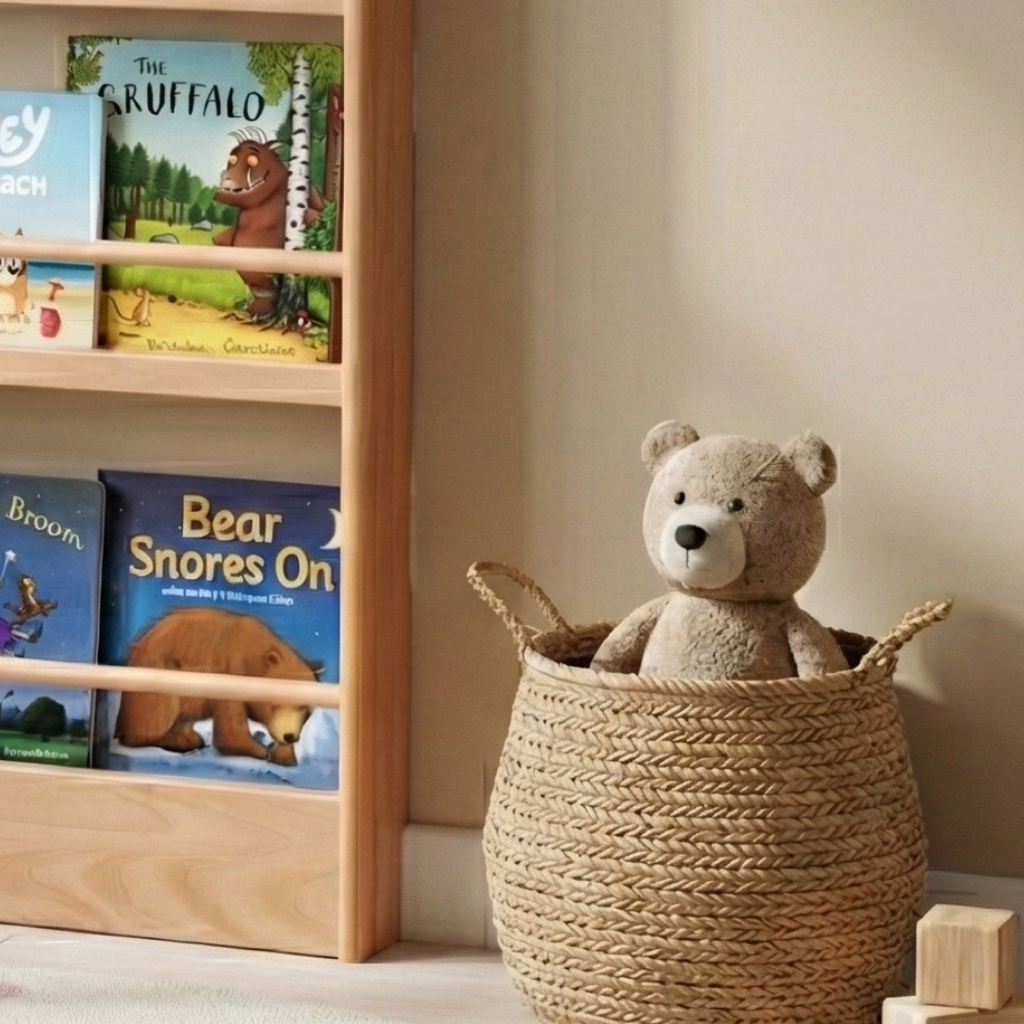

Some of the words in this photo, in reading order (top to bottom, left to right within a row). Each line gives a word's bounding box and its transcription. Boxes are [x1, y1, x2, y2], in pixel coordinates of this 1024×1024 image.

[5, 495, 84, 551] Broom
[182, 494, 282, 543] Bear
[129, 535, 265, 585] Snores
[276, 546, 335, 592] On
